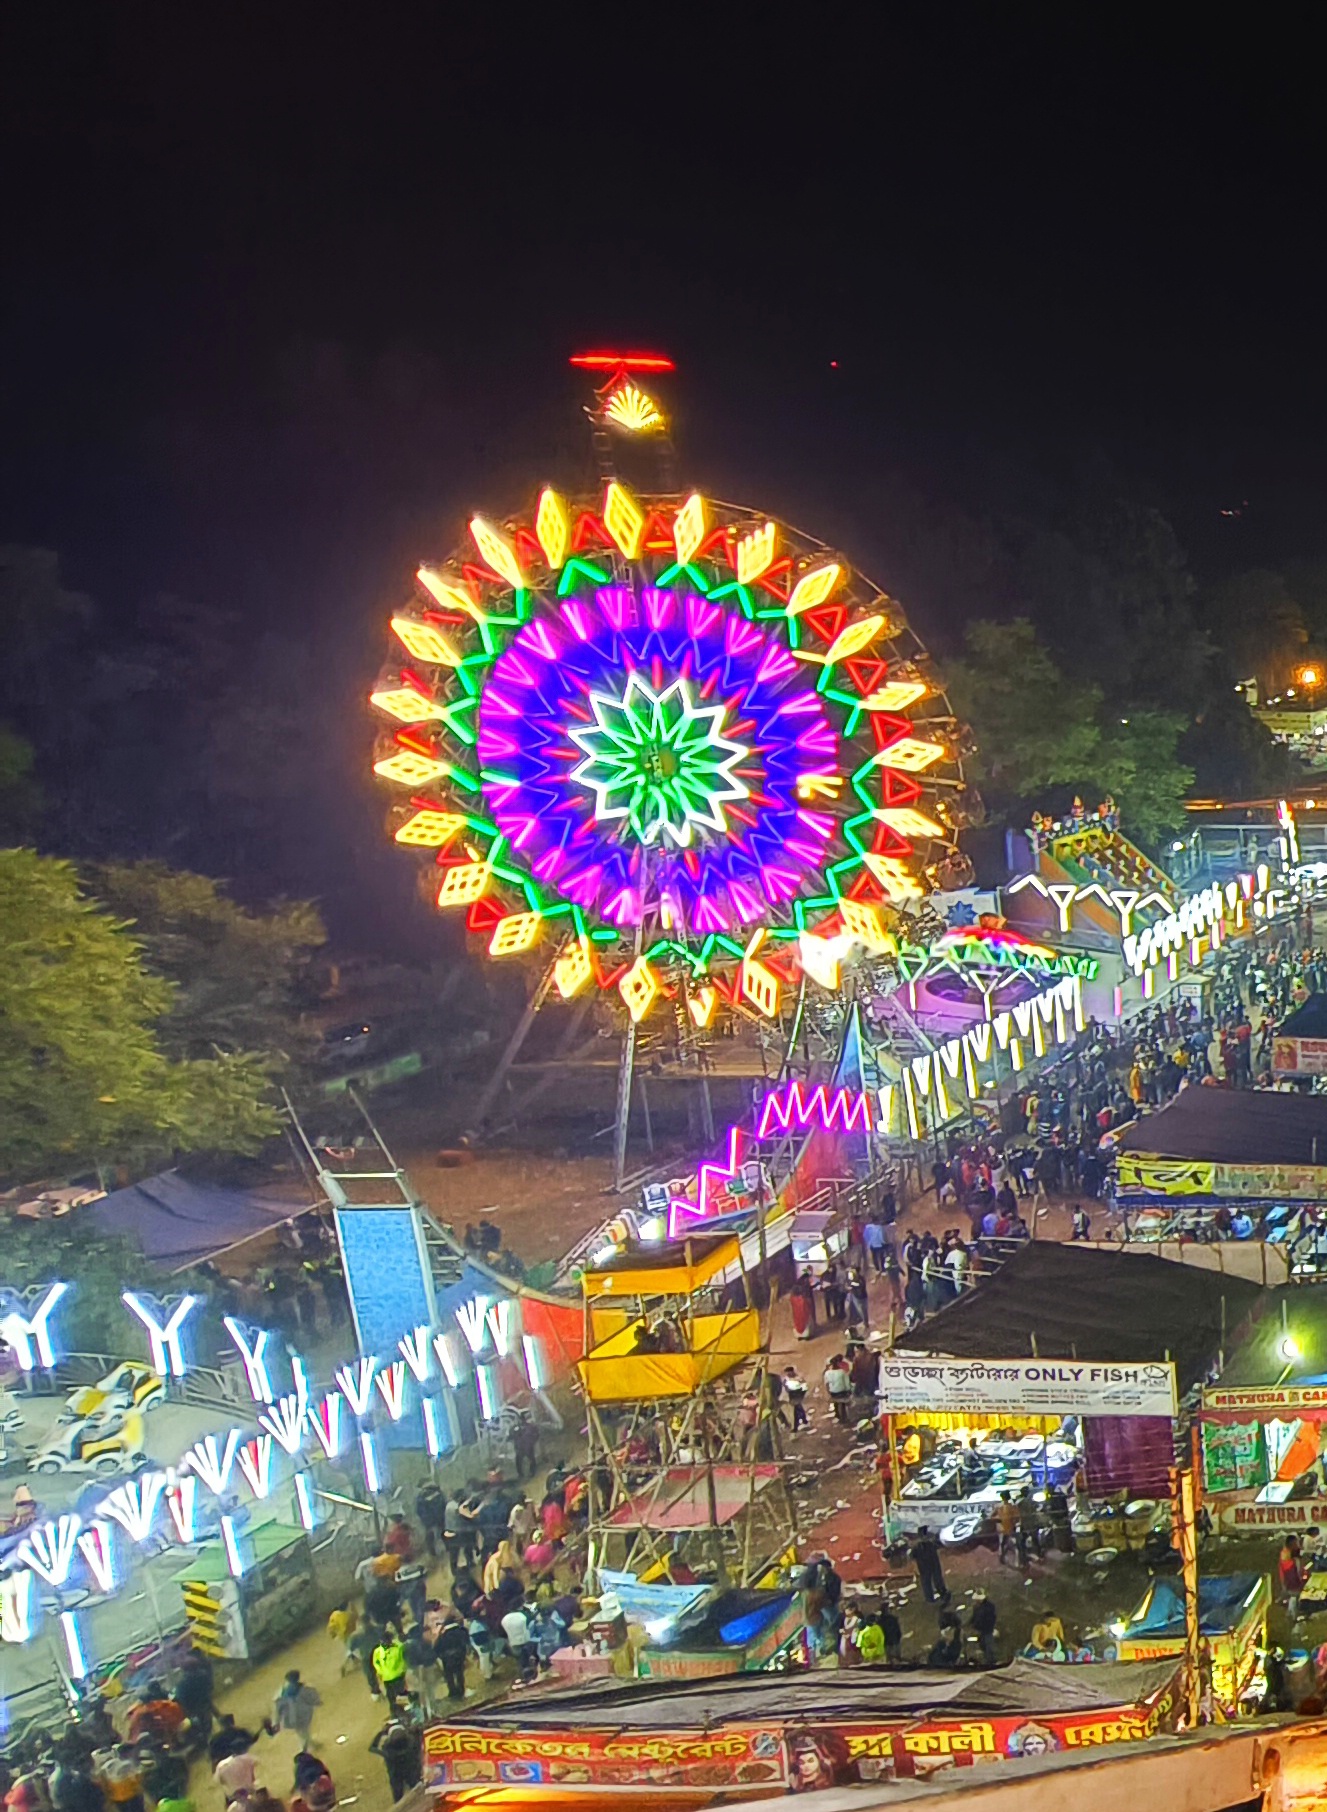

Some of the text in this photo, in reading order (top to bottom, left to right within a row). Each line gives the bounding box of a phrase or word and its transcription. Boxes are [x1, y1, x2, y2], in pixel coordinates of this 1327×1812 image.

[1025, 1368, 1083, 1382] ONLY
[1090, 1369, 1138, 1383] FISH
[1215, 1393, 1285, 1405] MATHURA
[1234, 1505, 1306, 1525] MATHURA
[901, 1722, 996, 1754] কালী
